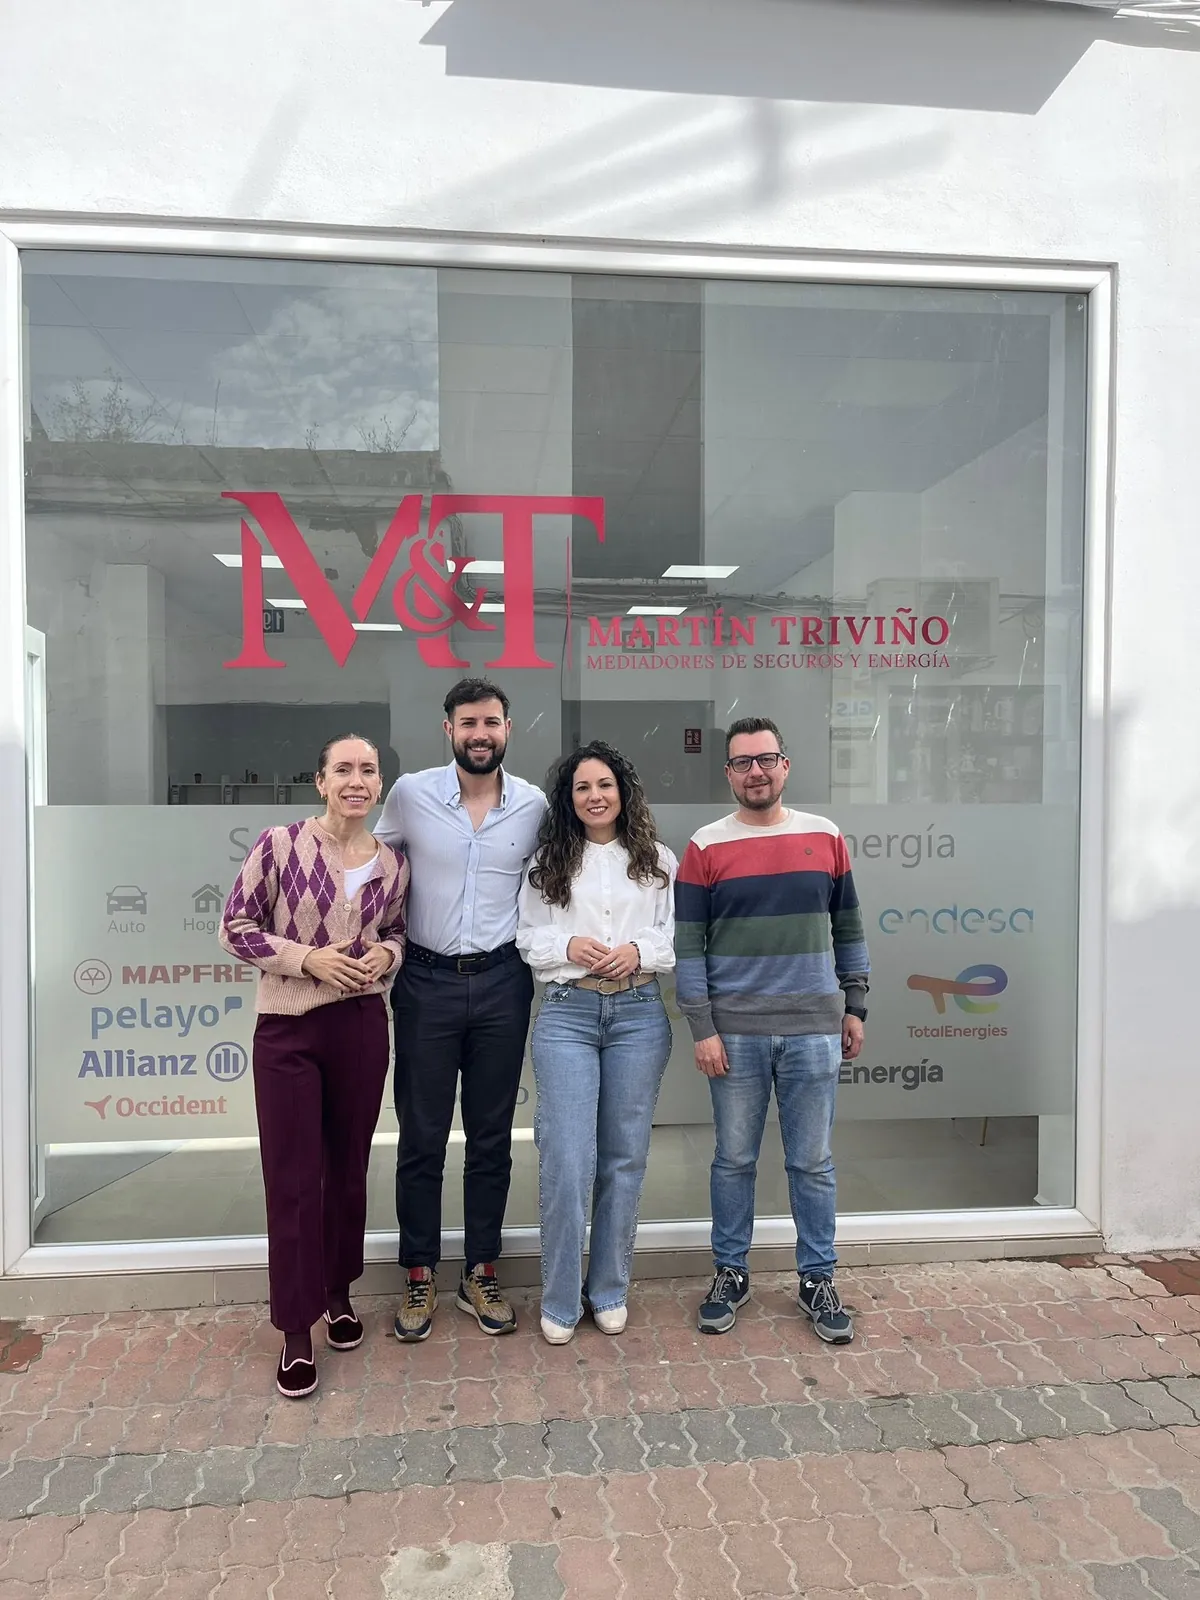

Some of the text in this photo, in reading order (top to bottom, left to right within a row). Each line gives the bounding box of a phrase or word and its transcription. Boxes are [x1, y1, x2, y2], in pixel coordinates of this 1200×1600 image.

[221, 491, 606, 668] M&T
[587, 607, 950, 647] MARTÍN TRIVIÑO
[586, 650, 950, 670] MEDIADORES DE SEGUROS Y ENERGÍA
[844, 823, 956, 869] nergía
[107, 919, 146, 933] Auto
[184, 917, 220, 935] Hog
[878, 904, 1034, 934] endesa
[122, 963, 254, 985] MAPFRE
[91, 997, 220, 1040] pelayo
[906, 1024, 1008, 1040] TotalEnergies
[78, 1050, 197, 1079] Allianz
[115, 1095, 227, 1118] Occident
